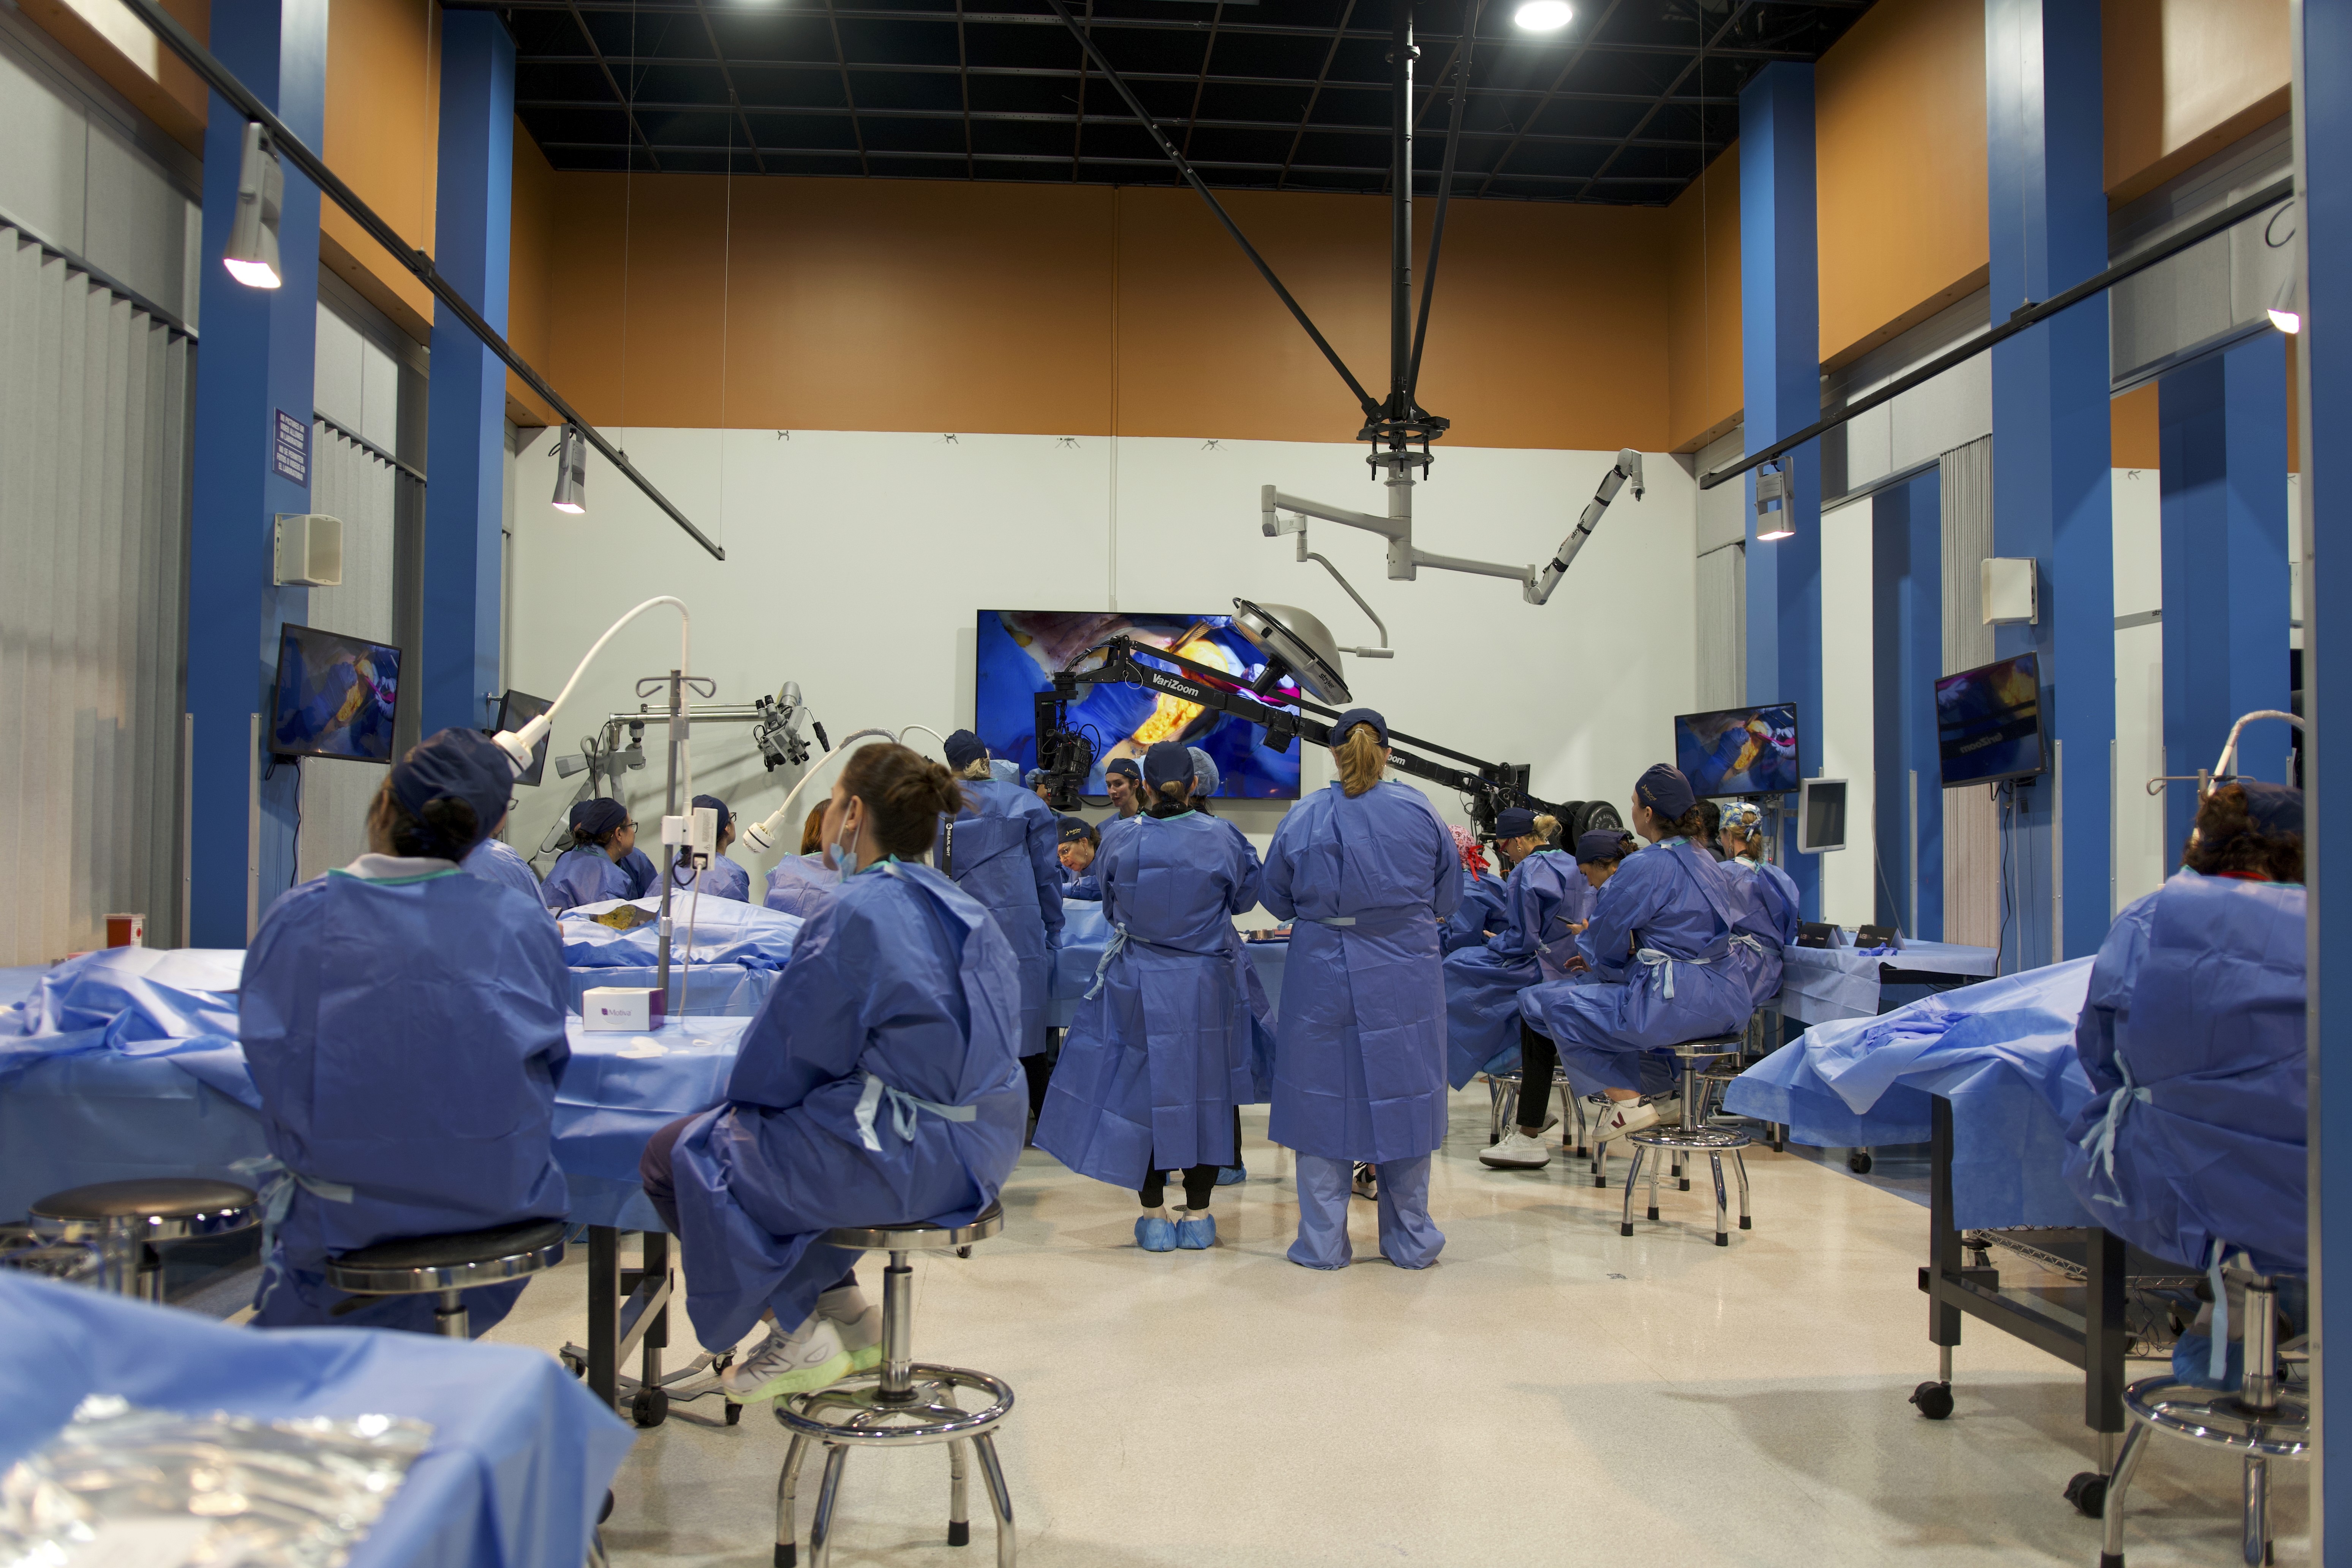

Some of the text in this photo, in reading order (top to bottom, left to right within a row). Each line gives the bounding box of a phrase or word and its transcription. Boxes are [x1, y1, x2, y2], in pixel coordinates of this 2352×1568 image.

[280, 413, 304, 433] NO PICTURES OR
[280, 422, 303, 441] VIDEO ALLOWED
[284, 433, 303, 449] LABORATORY
[277, 453, 286, 463] FOTOS
[290, 459, 300, 471] VIDEOS
[300, 465, 305, 473] EN
[279, 445, 284, 453] NO
[289, 450, 303, 464] PERMITEN
[283, 464, 303, 481] LABORATORIO
[1571, 518, 1585, 540] stryer
[1153, 673, 1199, 696] VariZoom
[1319, 673, 1334, 689] stryker
[1603, 814, 1618, 829] AUTHOR
